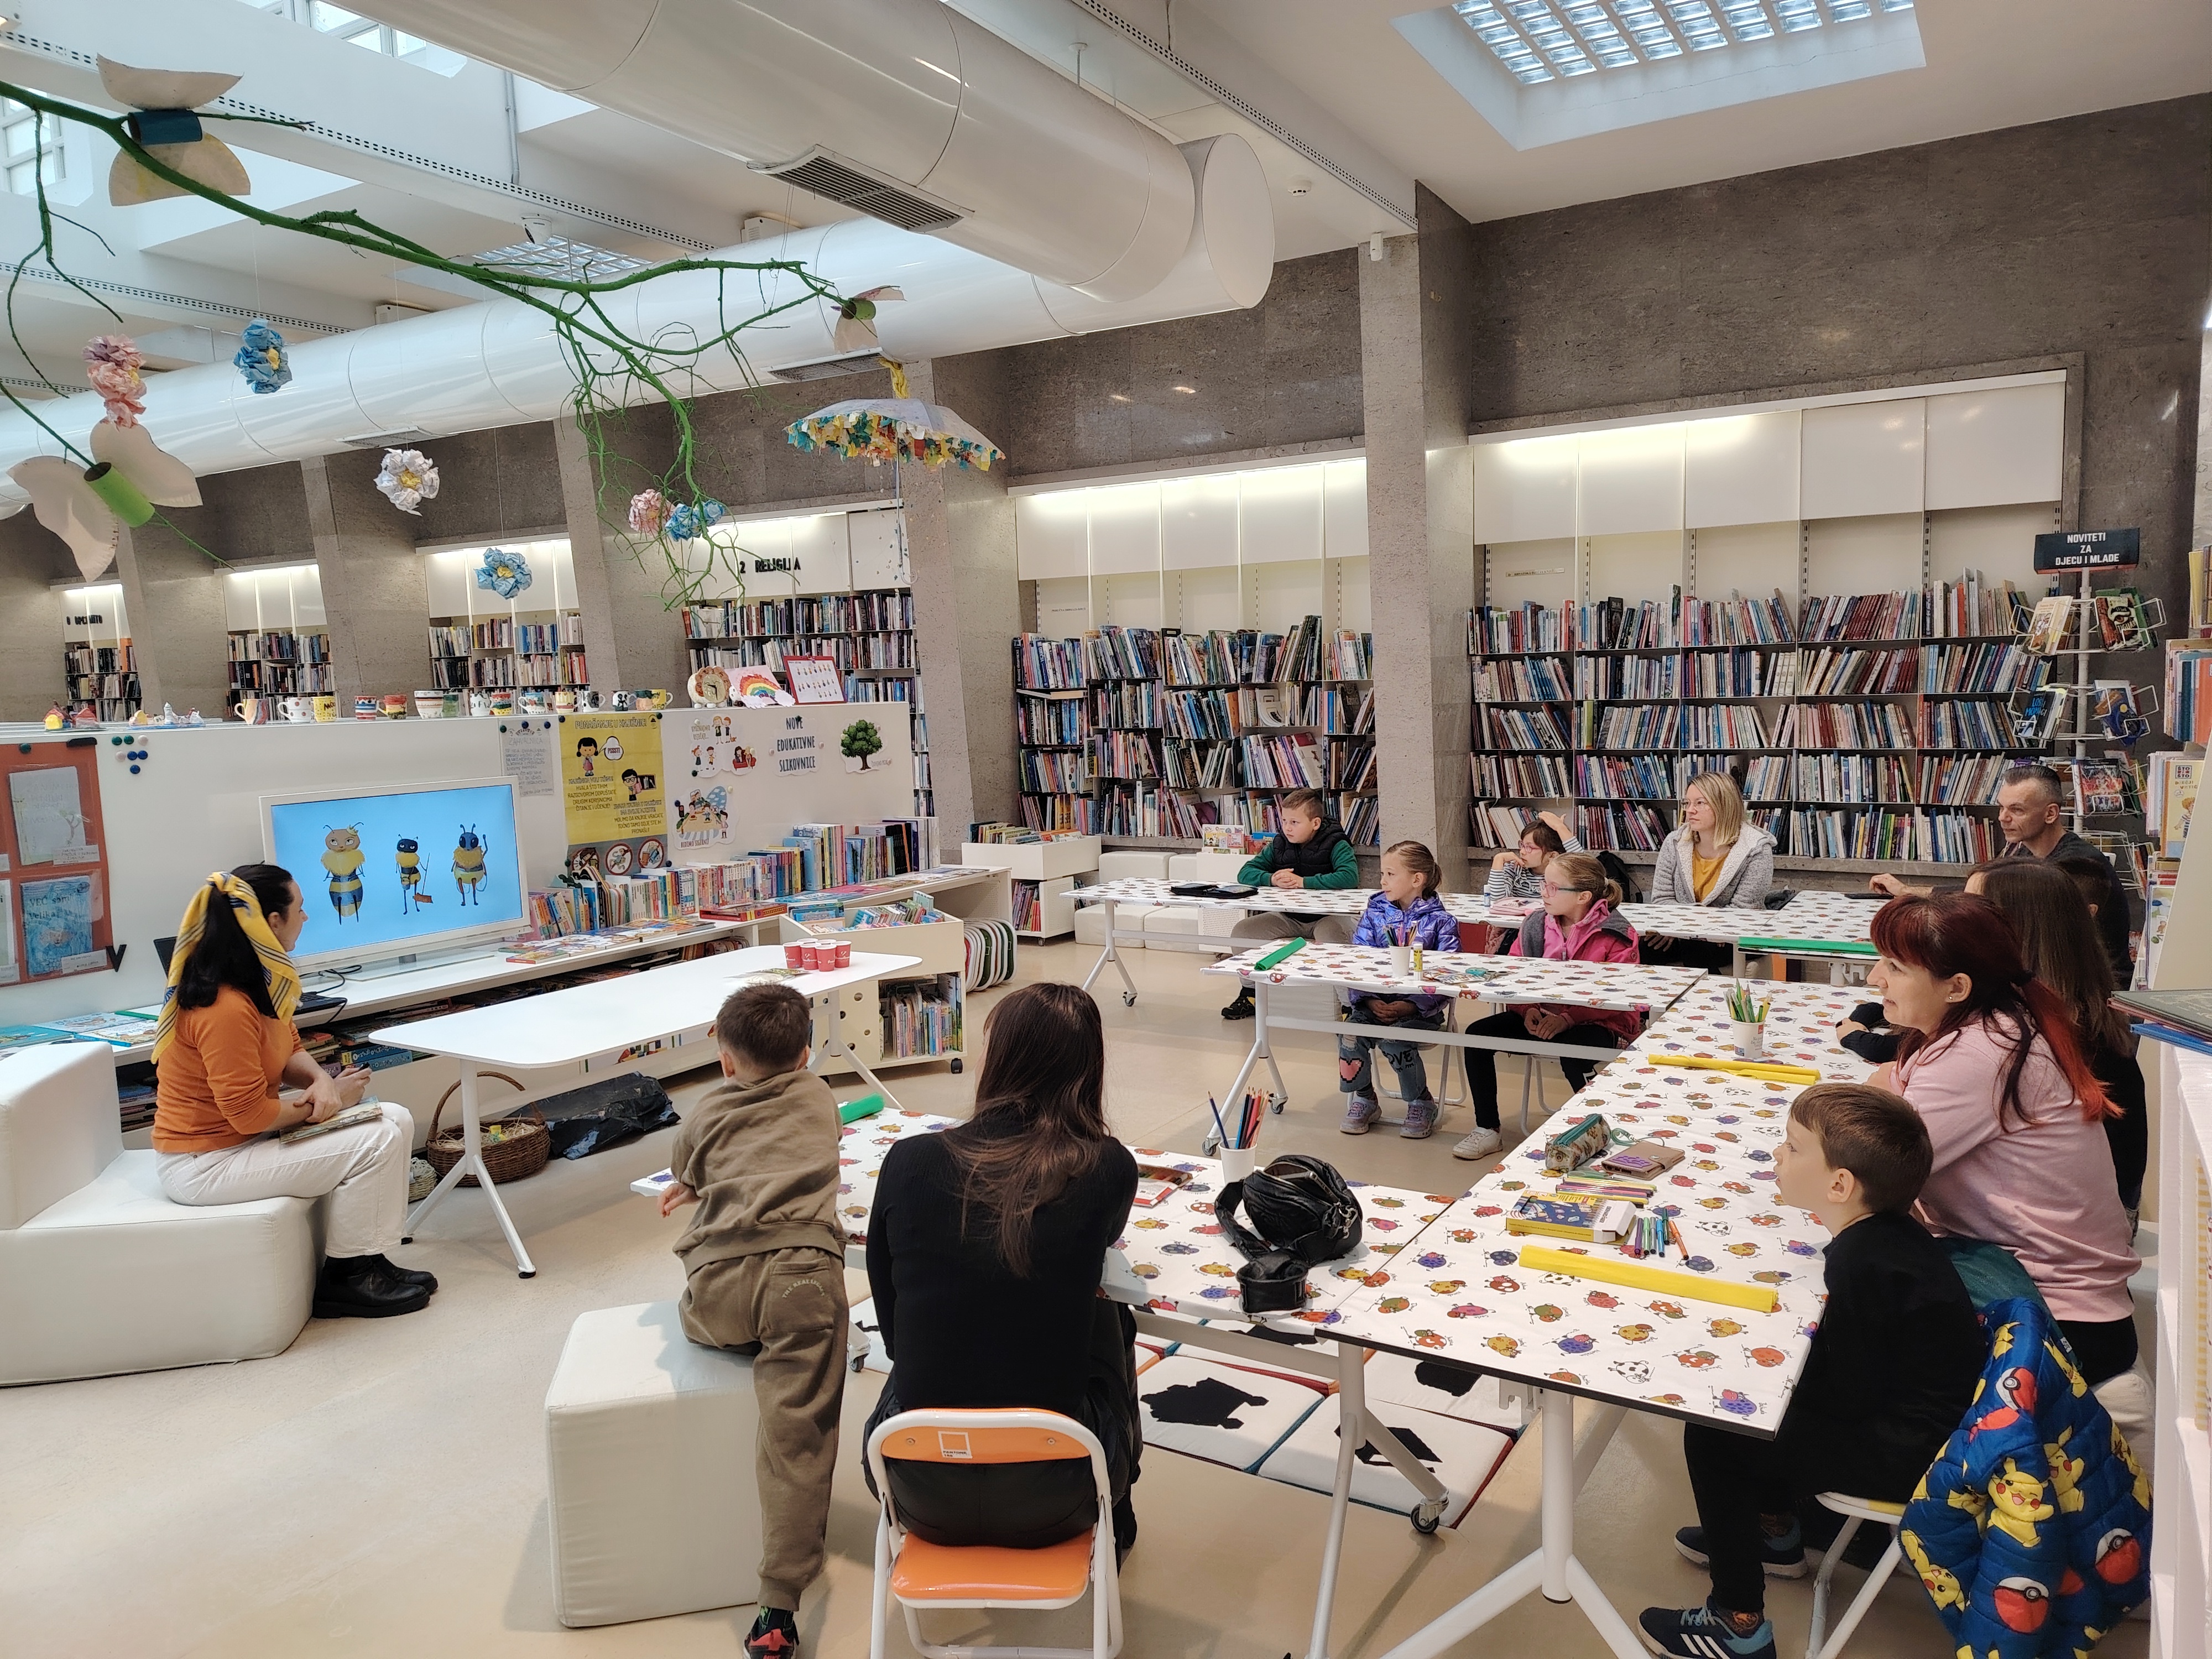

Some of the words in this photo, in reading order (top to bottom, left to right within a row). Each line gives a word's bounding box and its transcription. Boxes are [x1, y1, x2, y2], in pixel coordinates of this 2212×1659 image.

[2067, 532, 2106, 544] NOVITETI
[2080, 545, 2092, 554] ZA
[739, 561, 746, 573] 2
[754, 557, 801, 573] RELIGIJA
[2056, 555, 2082, 566] DJECU
[2084, 555, 2088, 564] I
[2090, 554, 2120, 564] MLADE
[575, 718, 613, 729] PONAŠANJE
[786, 717, 804, 730] NOVE
[777, 736, 816, 752] EDUKATIVNE
[779, 756, 816, 772] SLIKOVNICE
[29, 895, 48, 906] VEĆ
[781, 1286, 794, 1298] THE
